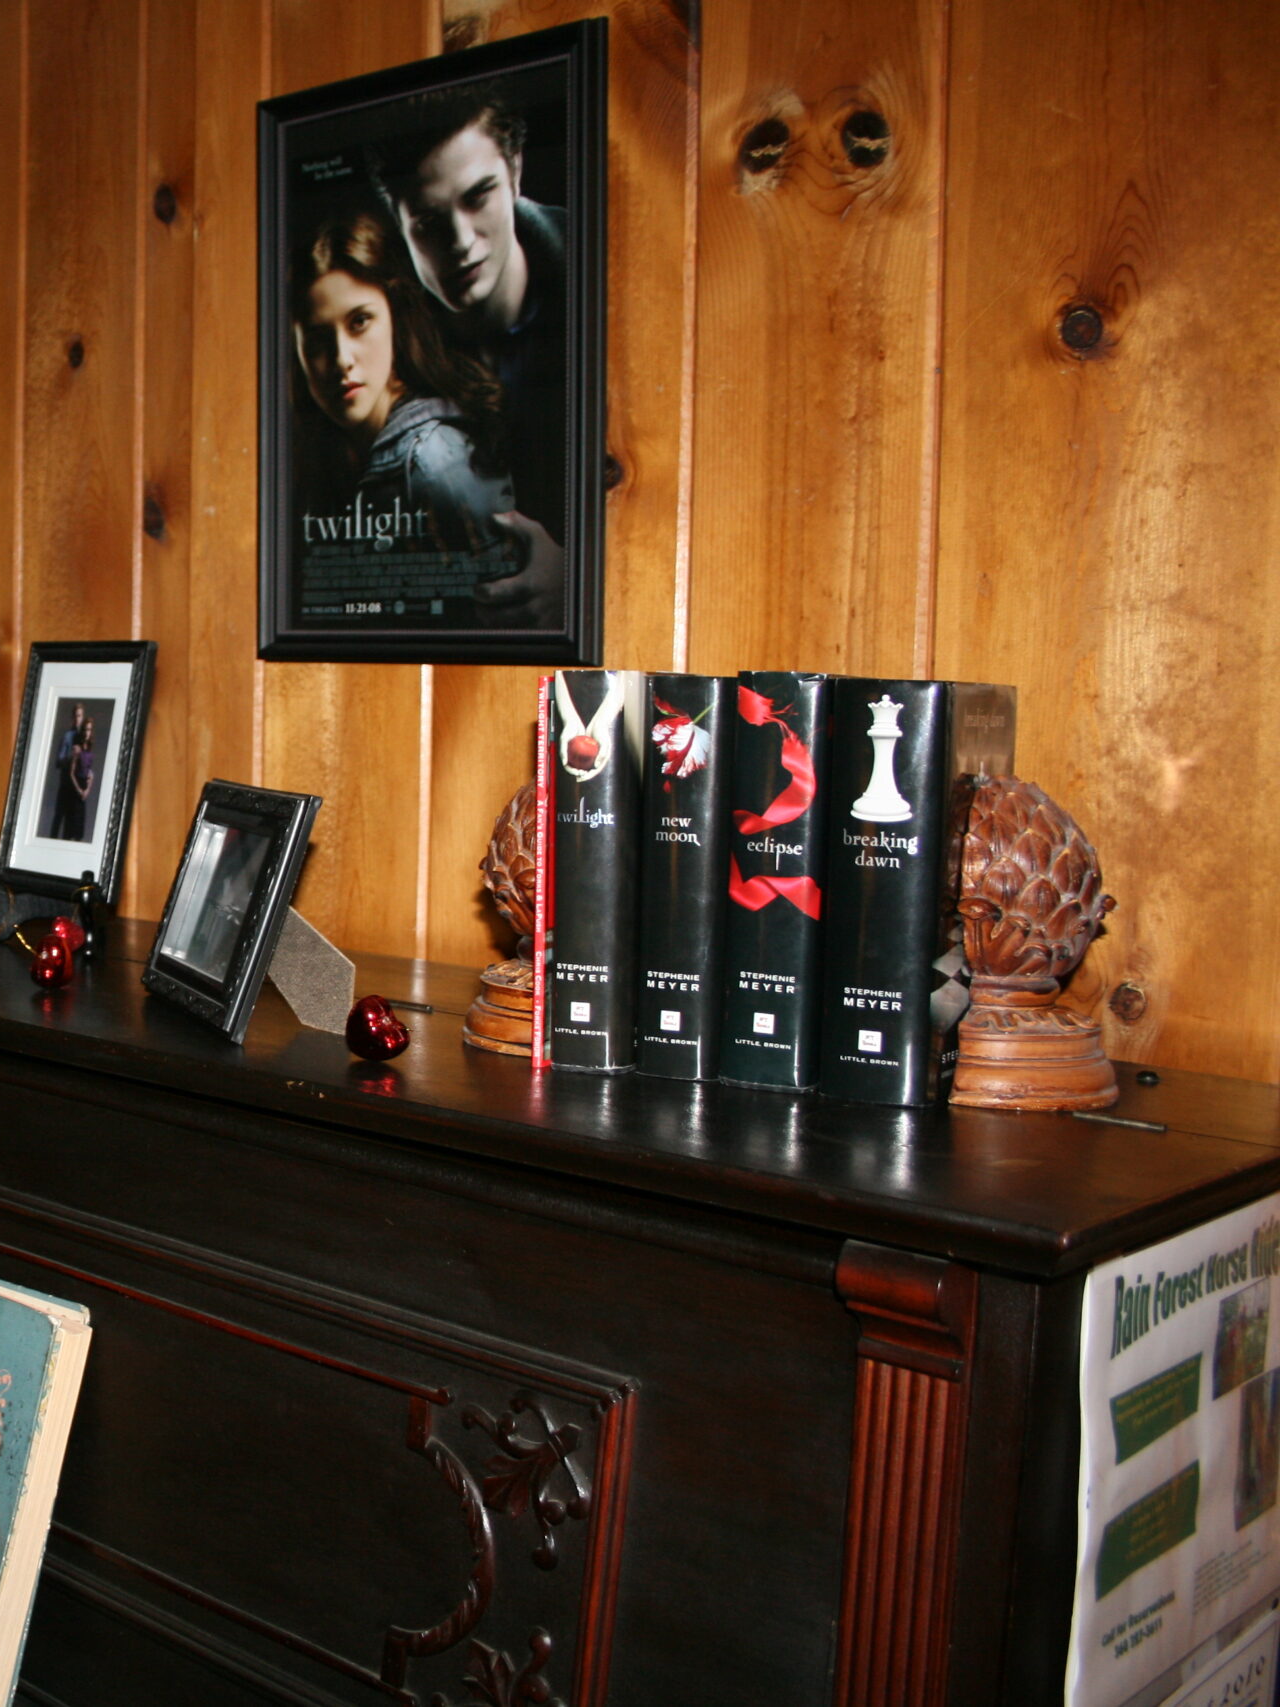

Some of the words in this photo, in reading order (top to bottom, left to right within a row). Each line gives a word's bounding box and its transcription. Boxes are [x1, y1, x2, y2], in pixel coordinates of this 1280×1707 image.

[302, 490, 427, 552] twilight
[537, 734, 545, 787] TERRITORY
[557, 796, 615, 828] twilight
[661, 815, 692, 828] new
[655, 831, 701, 847] moon
[843, 828, 918, 855] breaking
[747, 836, 804, 871] eclipse
[854, 850, 900, 868] dawn
[556, 963, 609, 973] STEPHENIE
[556, 972, 609, 983] MEYER
[647, 970, 700, 982] STEPHENIE
[740, 971, 796, 984] STEPHENIE
[646, 980, 700, 992] MEYER
[739, 980, 795, 994] MEYER
[844, 987, 902, 999] STEPHENIE
[843, 997, 902, 1011] MEYER
[670, 1038, 698, 1046] BROWN
[763, 1042, 791, 1050] BROWN
[869, 1058, 899, 1067] BROWN
[1111, 1274, 1151, 1361] Rain
[1153, 1271, 1204, 1327] Forest
[1206, 1242, 1248, 1294] Horse
